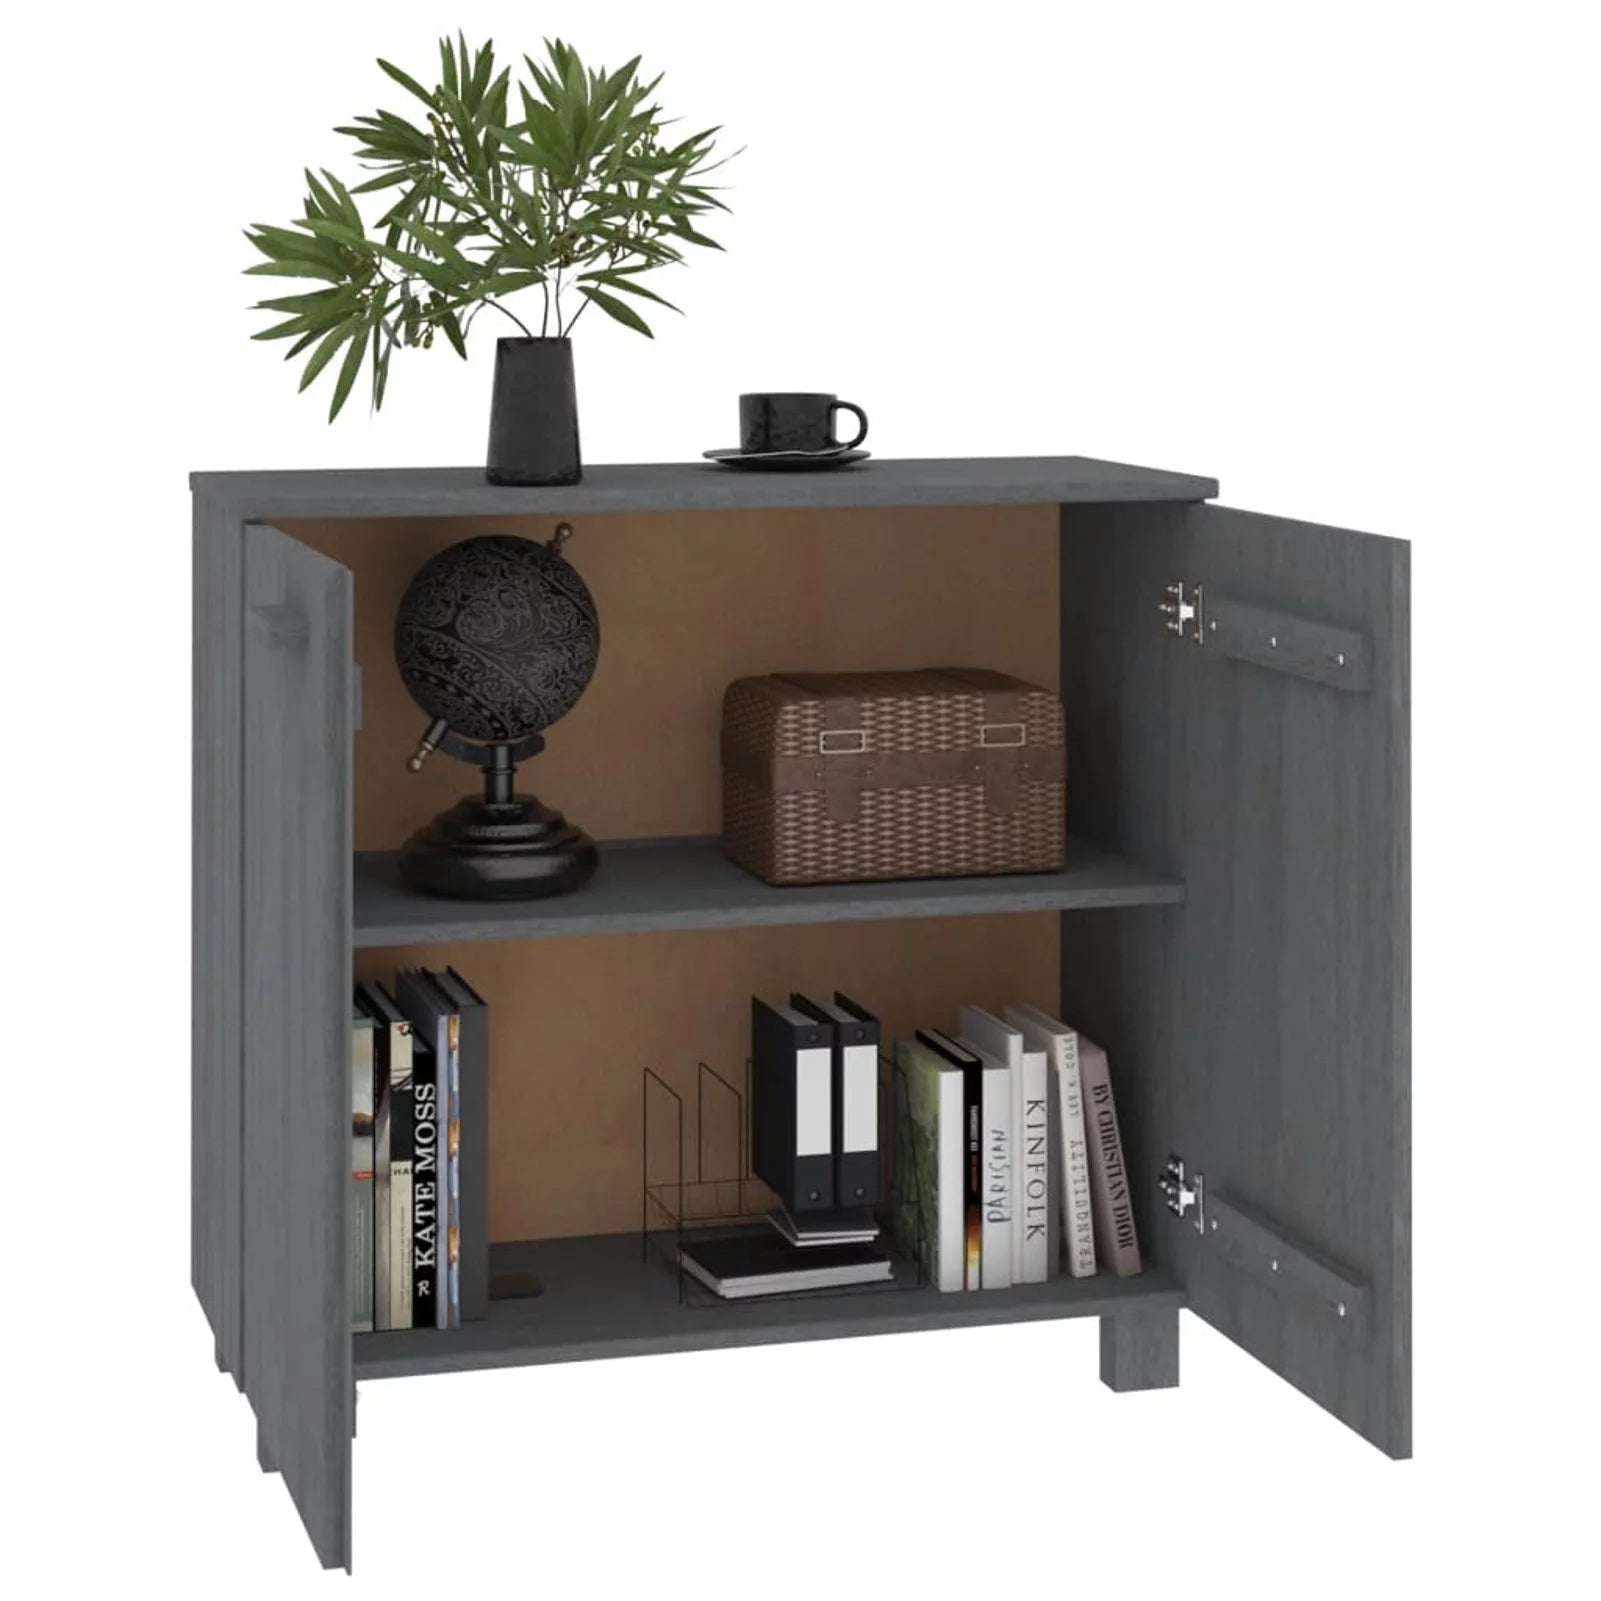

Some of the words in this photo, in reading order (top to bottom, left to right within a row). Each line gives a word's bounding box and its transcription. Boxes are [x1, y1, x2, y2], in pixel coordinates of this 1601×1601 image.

[415, 1082, 436, 1173] MOSS
[1093, 1084, 1110, 1107] BY
[985, 1129, 1011, 1223] PARISIAN
[1026, 1100, 1046, 1241] KINFOLK
[1097, 1110, 1126, 1201] CHRISTIAN
[415, 1181, 436, 1270] KATE
[1069, 1139, 1092, 1270] TRANQUILITY
[1112, 1204, 1134, 1250] DIOR
